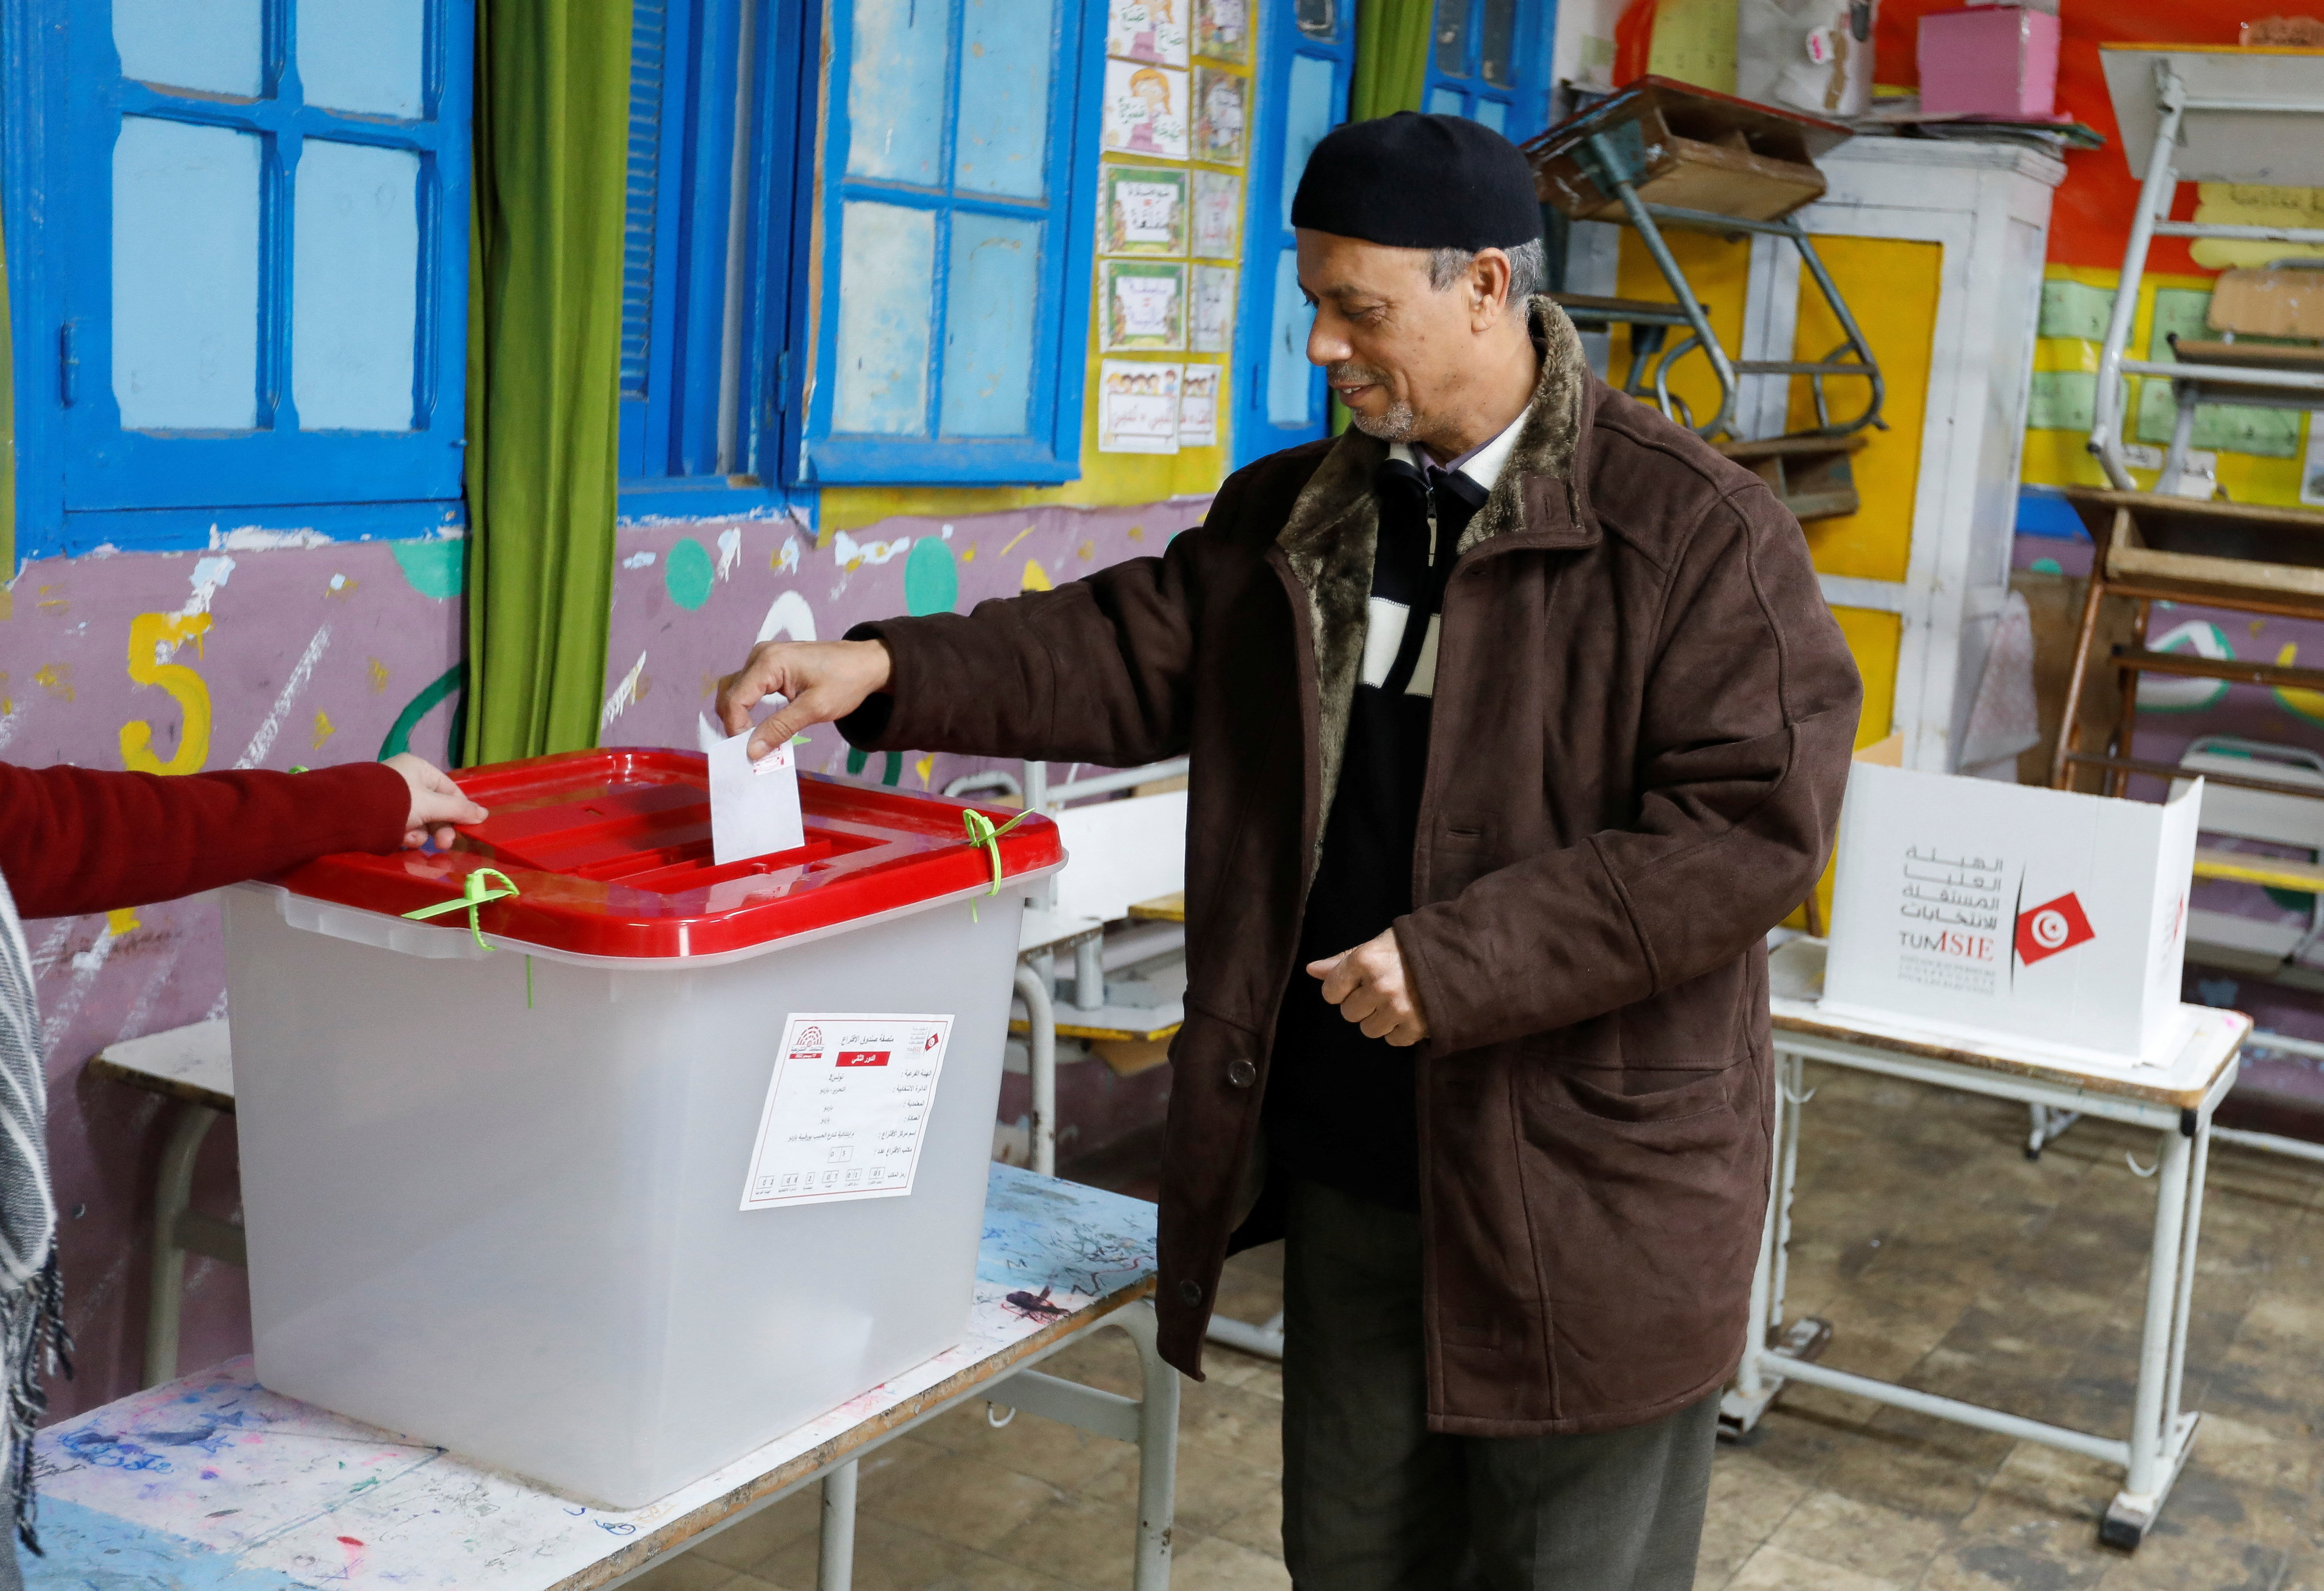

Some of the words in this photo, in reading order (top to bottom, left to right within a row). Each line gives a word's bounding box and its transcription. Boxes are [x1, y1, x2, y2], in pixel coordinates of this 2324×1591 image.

[120, 612, 212, 776] 5
[841, 1034, 860, 1046] الاقتراع
[860, 1035, 878, 1045] صندوق
[881, 1130, 897, 1140] الاقتراع
[886, 1146, 902, 1157] الاقتراع
